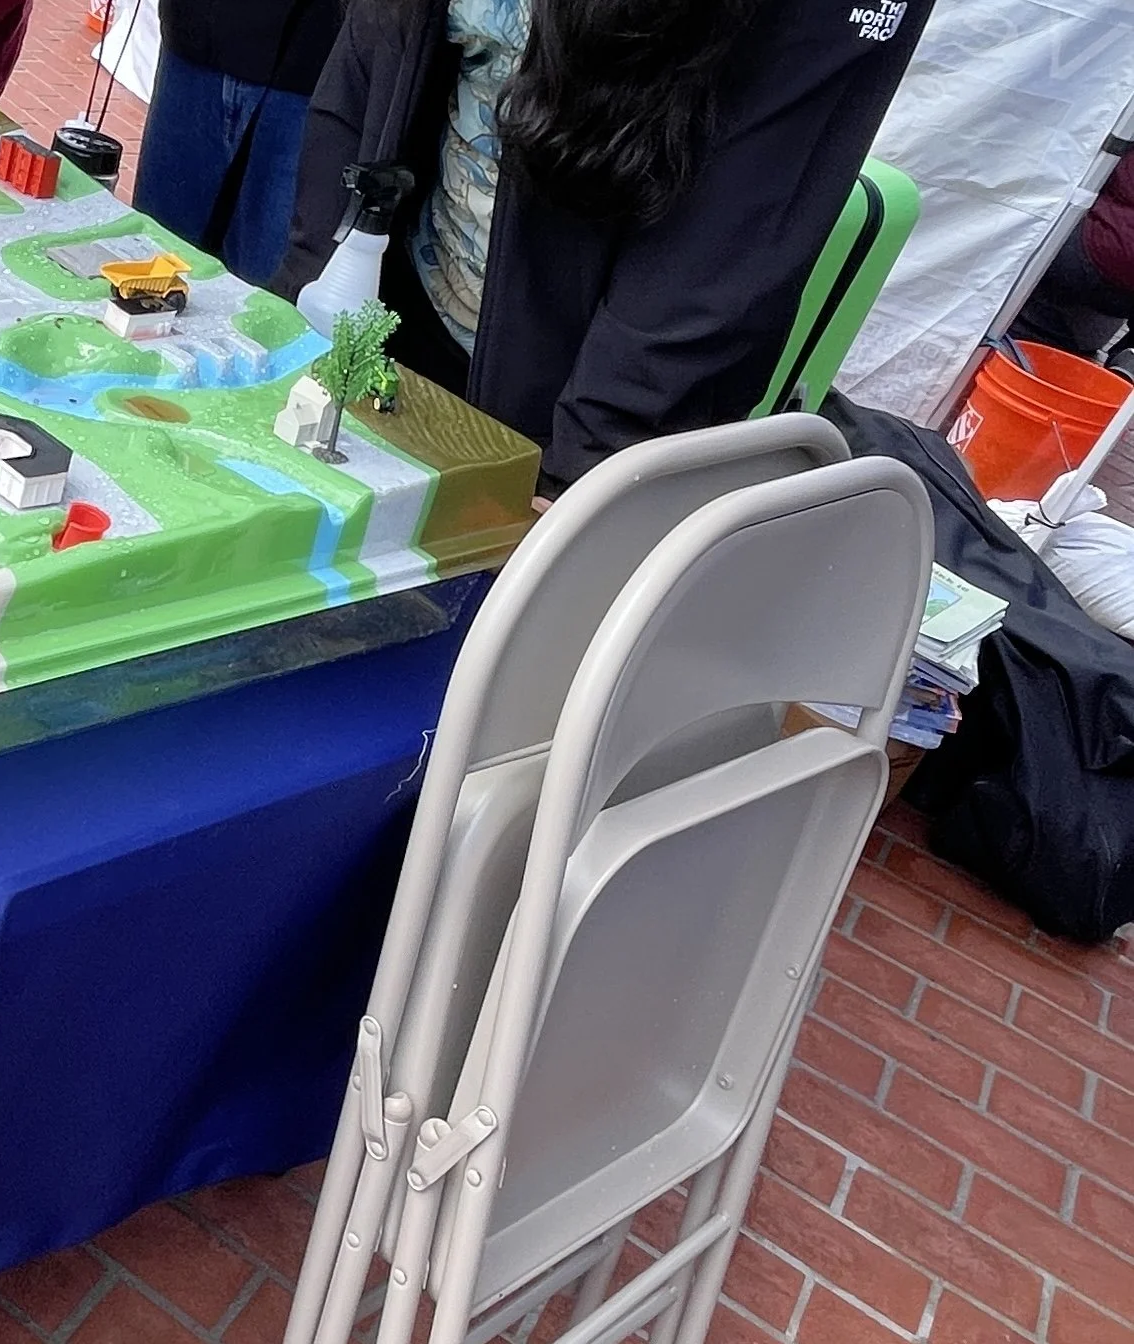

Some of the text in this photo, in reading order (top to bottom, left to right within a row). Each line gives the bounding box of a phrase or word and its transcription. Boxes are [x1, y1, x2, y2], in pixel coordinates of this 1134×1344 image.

[880, 0, 903, 15] TH
[848, 8, 897, 28] NORT
[858, 25, 892, 42] FAC
